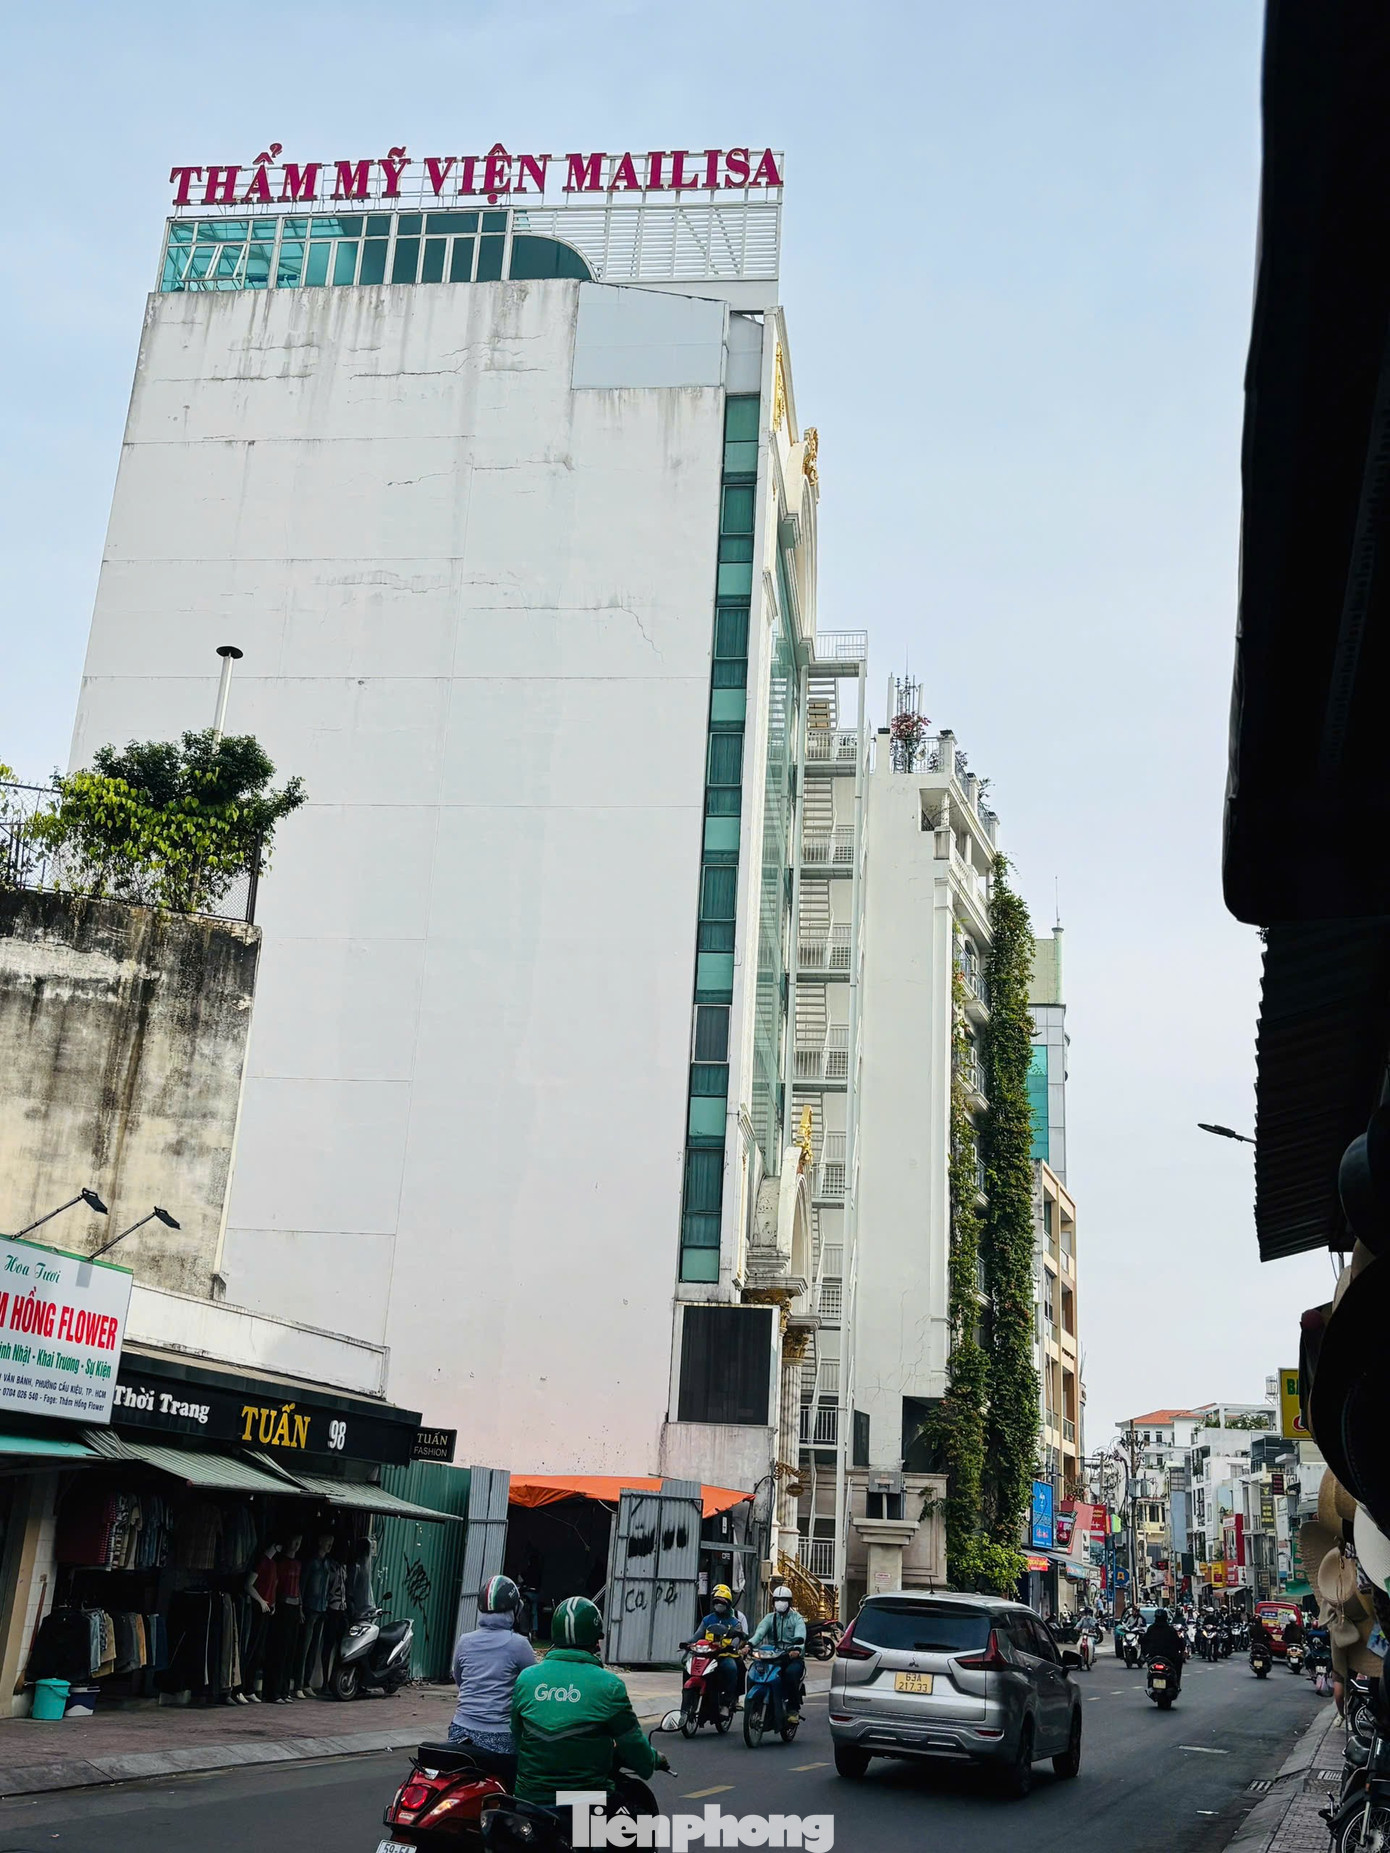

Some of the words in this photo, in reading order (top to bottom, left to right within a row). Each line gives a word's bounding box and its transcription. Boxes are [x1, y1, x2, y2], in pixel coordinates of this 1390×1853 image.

[170, 143, 322, 206] THẨM
[331, 146, 411, 199] MỸ
[424, 143, 552, 204] VIỆN
[562, 148, 783, 193] MAILISA
[4, 1255, 30, 1276] Hoa
[35, 1262, 61, 1283] Tươi
[9, 1286, 57, 1338] HỒNG
[57, 1305, 118, 1351] FLOWER
[12, 1344, 31, 1366] Nhật
[36, 1348, 55, 1368] Khai
[55, 1352, 80, 1374] Trương
[85, 1358, 96, 1378] Sự
[95, 1361, 112, 1381] Kiện
[88, 1401, 105, 1411] Flower
[95, 1389, 107, 1399] HCM
[114, 1385, 155, 1411] Thời
[159, 1393, 211, 1424] Trang
[241, 1402, 311, 1449] TUẤN
[328, 1419, 347, 1450] 98
[416, 1431, 449, 1446] TUẤN
[413, 1446, 448, 1457] FASHION
[898, 1681, 928, 1692] 217.33
[905, 1673, 922, 1682] 63A
[534, 1683, 581, 1703] Grab
